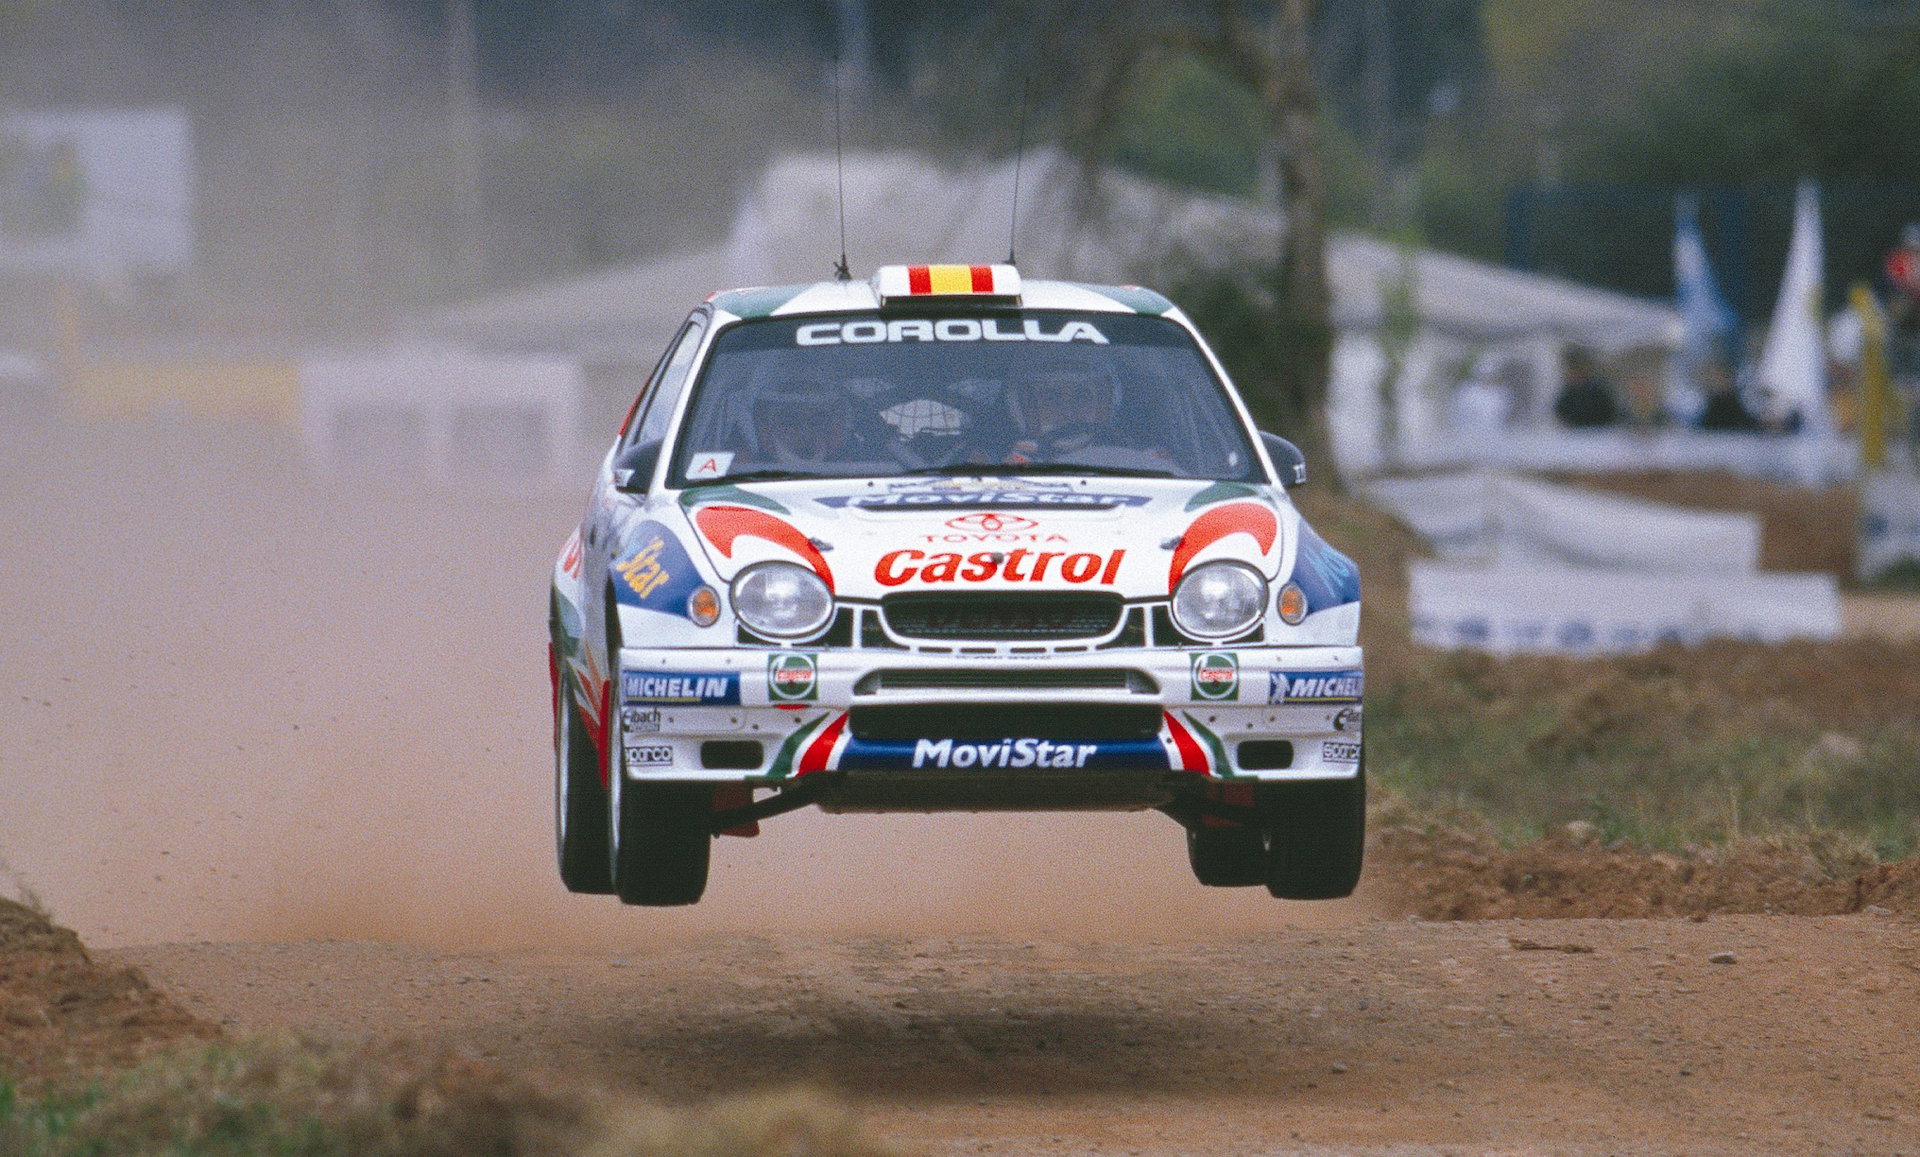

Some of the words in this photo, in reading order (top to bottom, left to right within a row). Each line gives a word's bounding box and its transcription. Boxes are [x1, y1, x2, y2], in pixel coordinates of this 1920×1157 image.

[796, 319, 1110, 345] COROLLA
[698, 458, 717, 473] A
[922, 534, 1070, 543] TOYOTA
[874, 548, 1127, 586] Castrol
[626, 677, 729, 697] MICHELIN
[912, 738, 1098, 768] MoviStar
